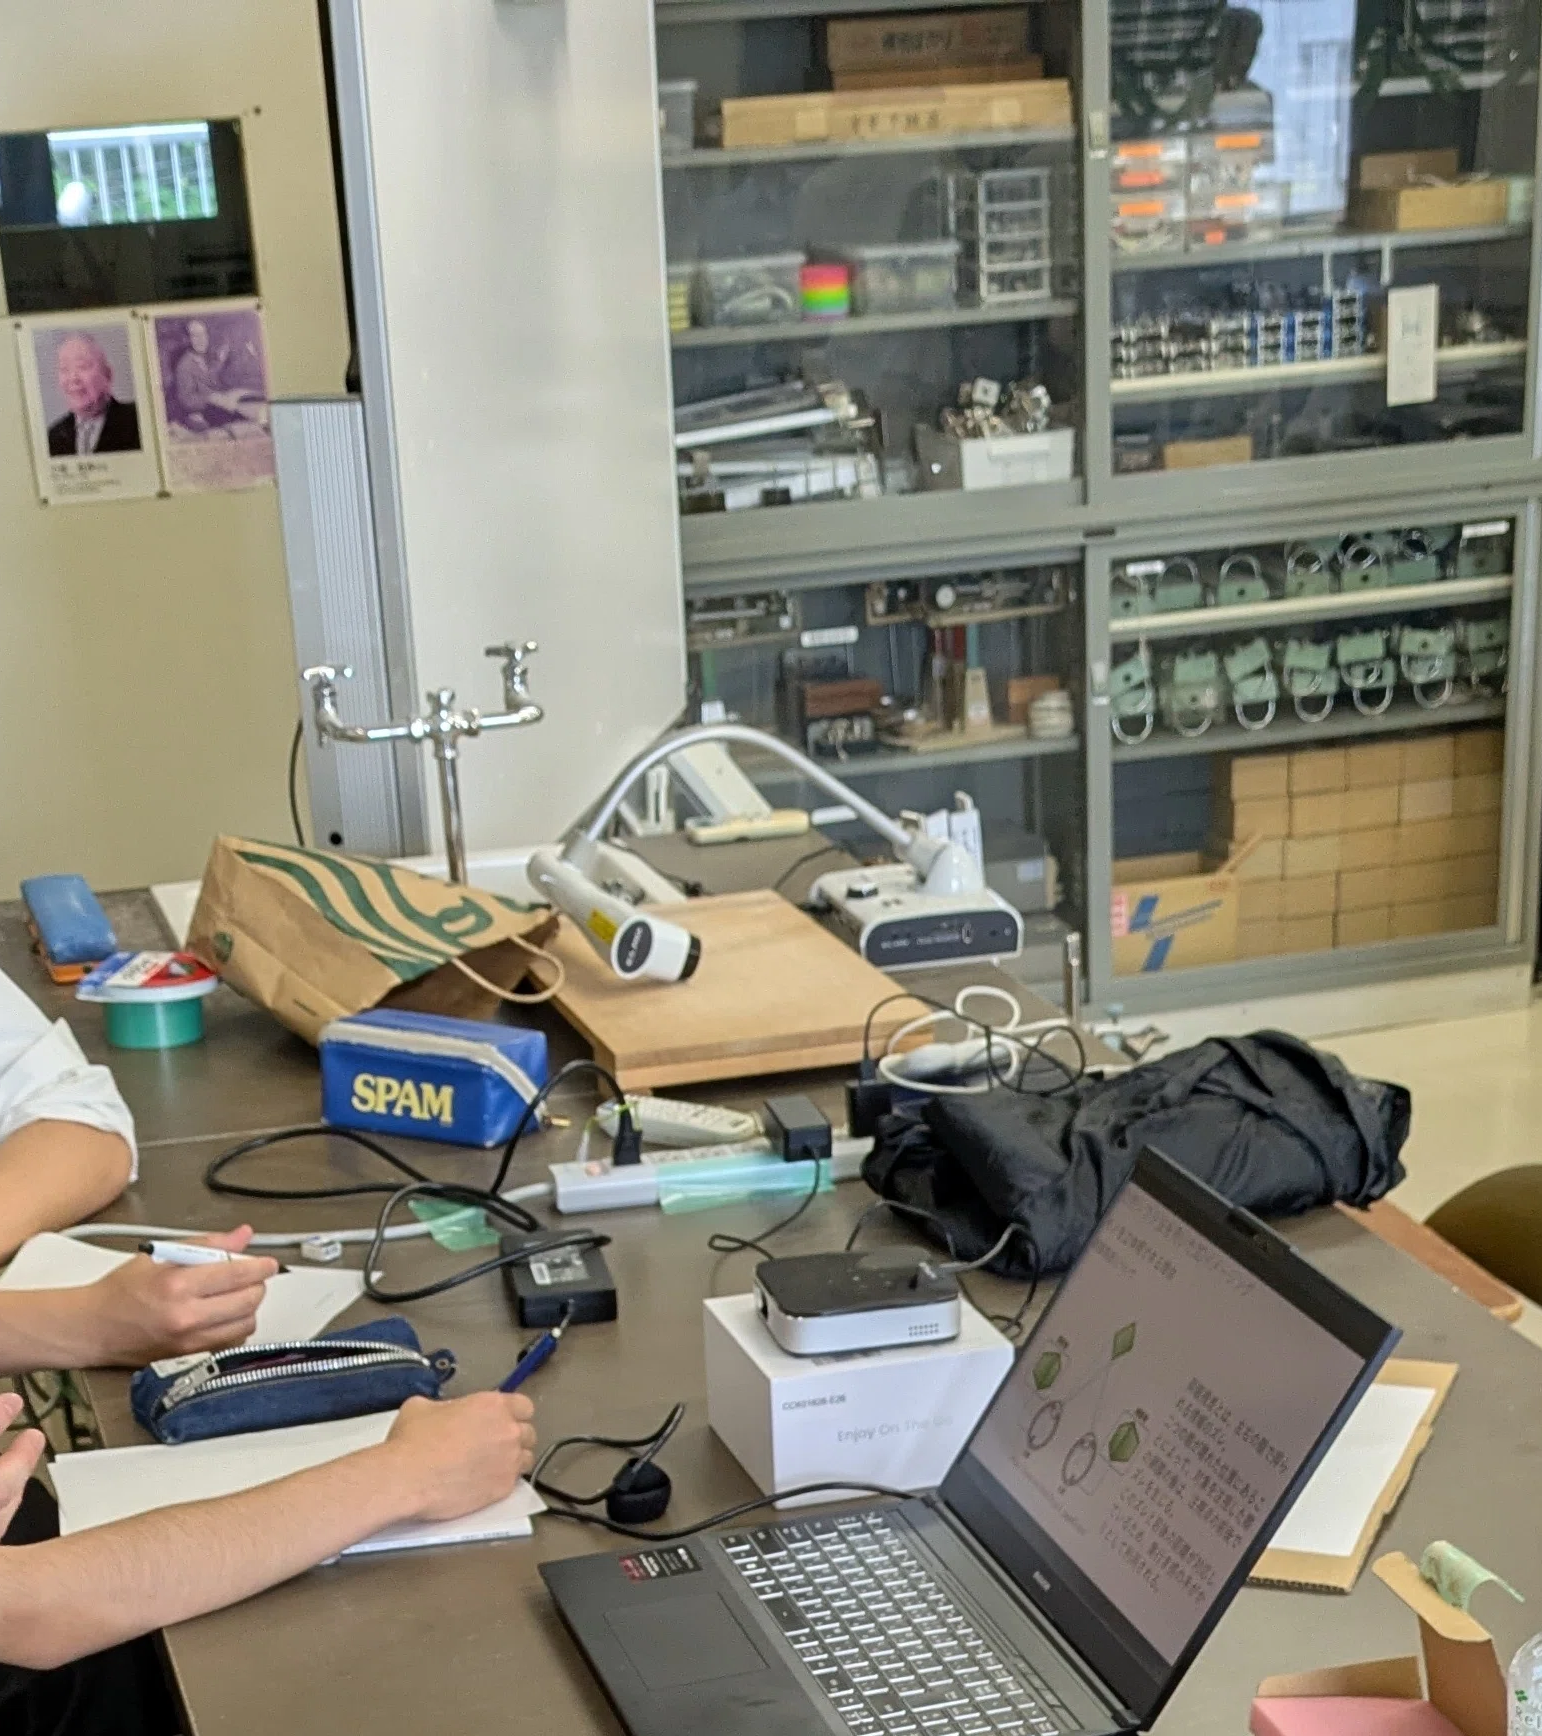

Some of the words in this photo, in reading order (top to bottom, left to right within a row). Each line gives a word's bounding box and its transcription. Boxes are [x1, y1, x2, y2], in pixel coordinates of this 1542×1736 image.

[352, 1073, 454, 1123] SPAM
[837, 1426, 875, 1444] Enjoy
[878, 1422, 900, 1437] On
[905, 1418, 928, 1433] The
